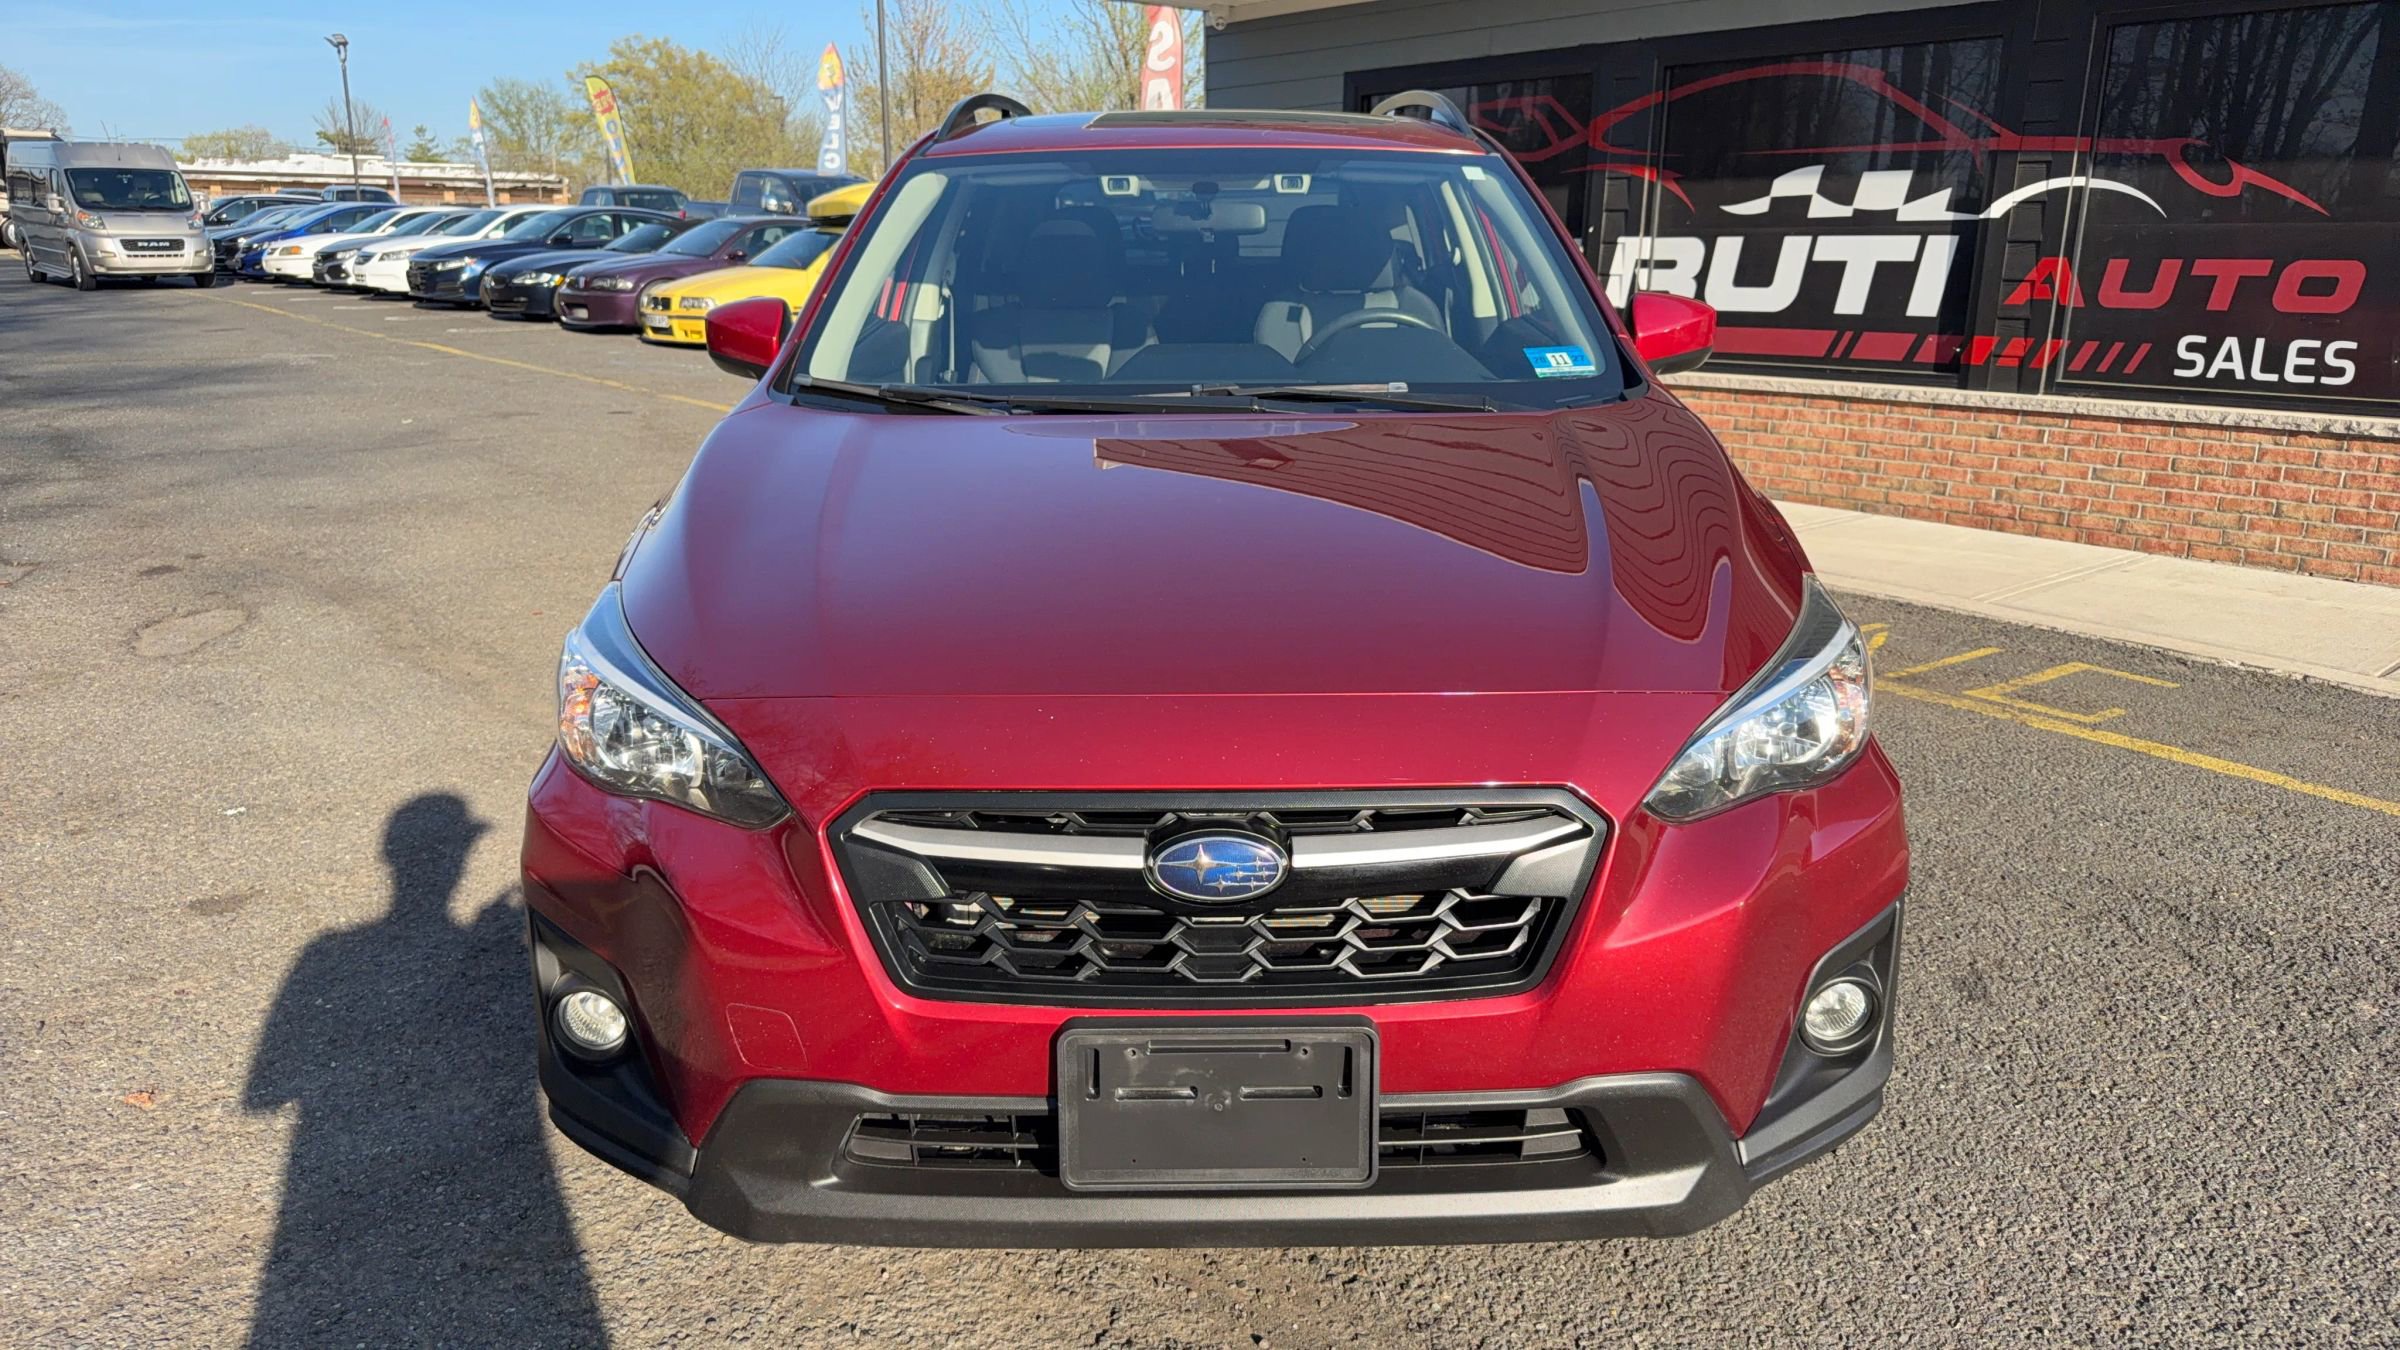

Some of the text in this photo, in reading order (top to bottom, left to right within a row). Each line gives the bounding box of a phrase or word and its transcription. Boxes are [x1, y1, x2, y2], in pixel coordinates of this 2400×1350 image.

[2003, 257, 2366, 314] AUTO
[1551, 353, 1570, 366] 11
[2173, 334, 2358, 385] SALES
